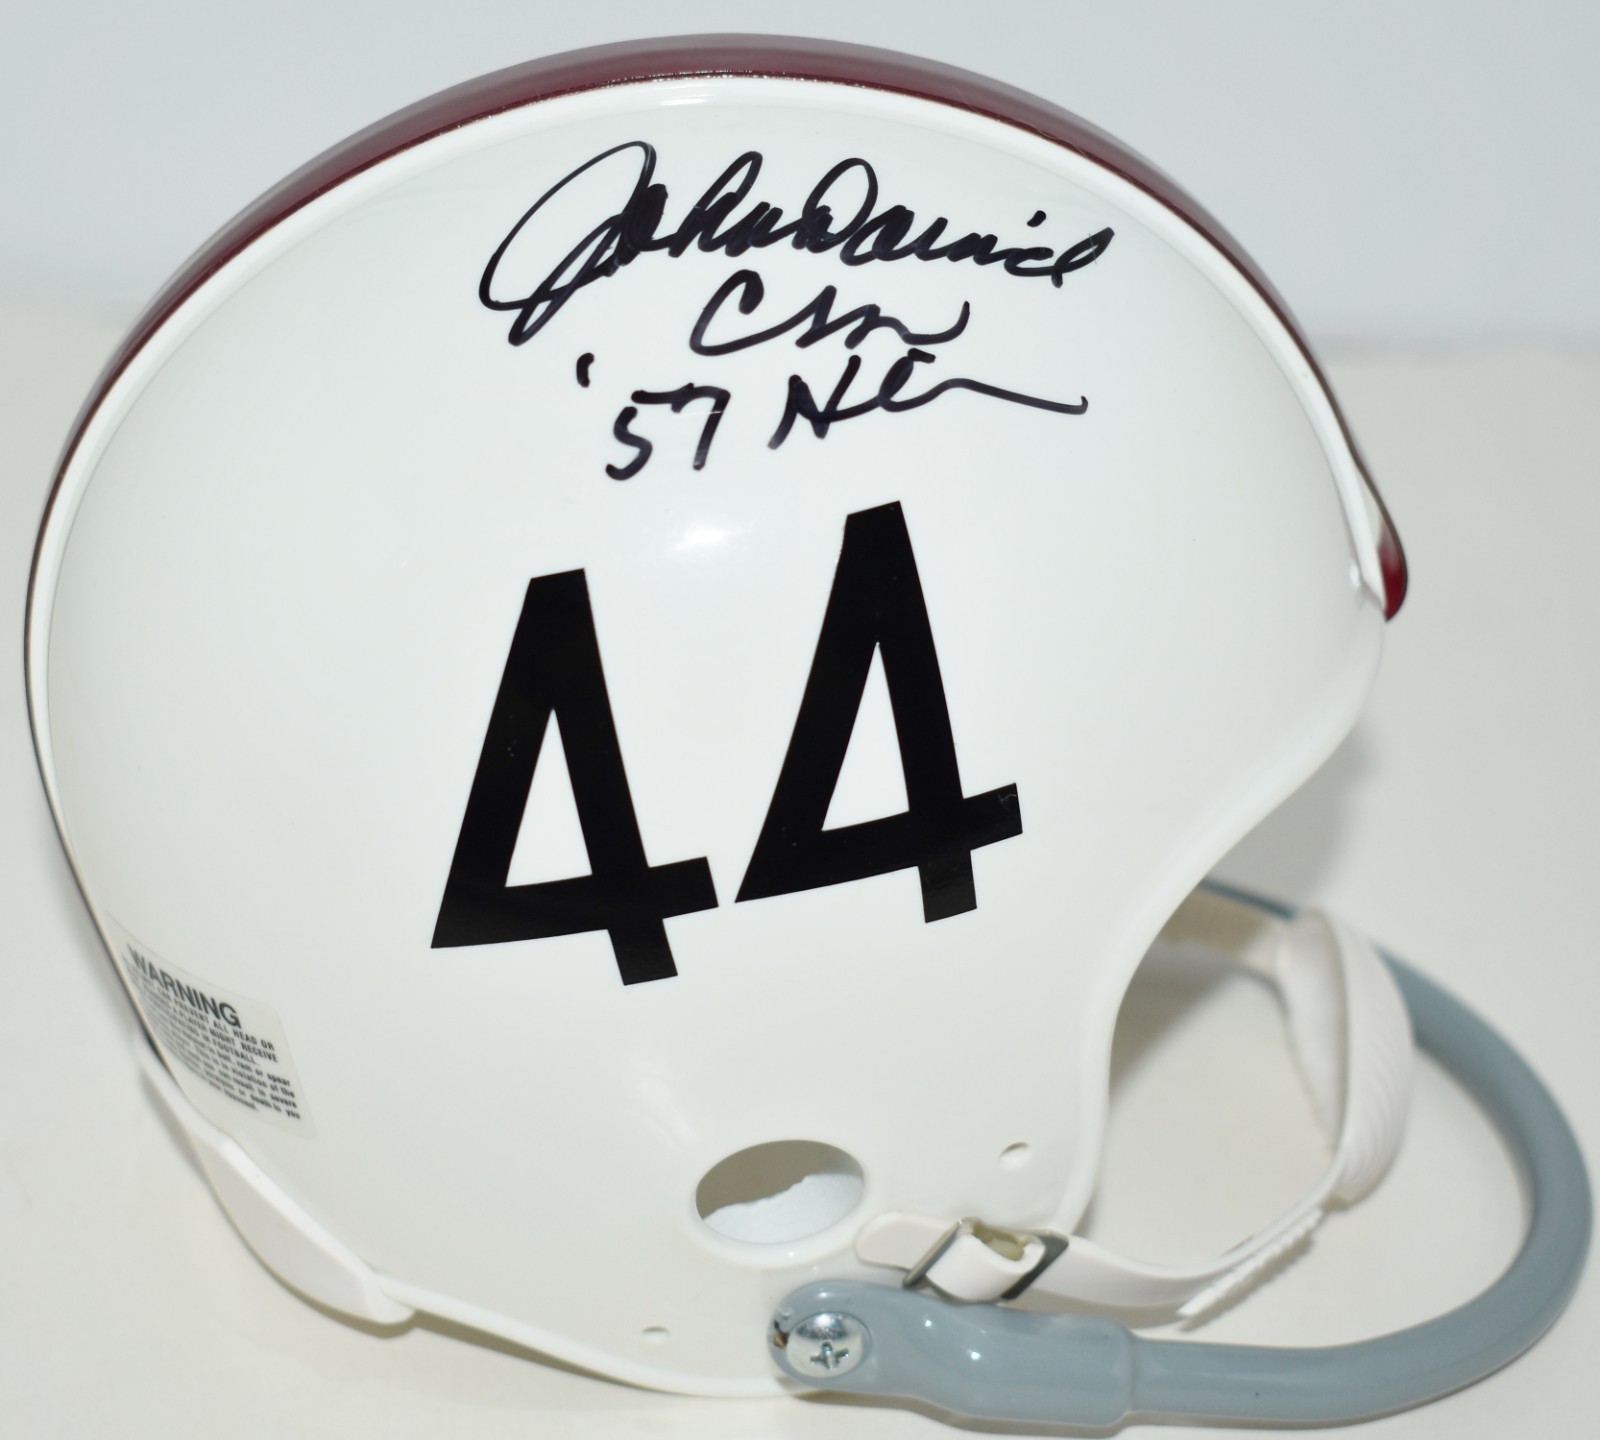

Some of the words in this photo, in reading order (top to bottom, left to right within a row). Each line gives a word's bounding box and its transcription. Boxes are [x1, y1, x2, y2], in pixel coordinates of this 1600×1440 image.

[127, 943, 241, 1029] WARNING
[233, 1027, 258, 1046] HEAD
[260, 1039, 275, 1052] OR
[241, 1041, 278, 1063] RECEIVE
